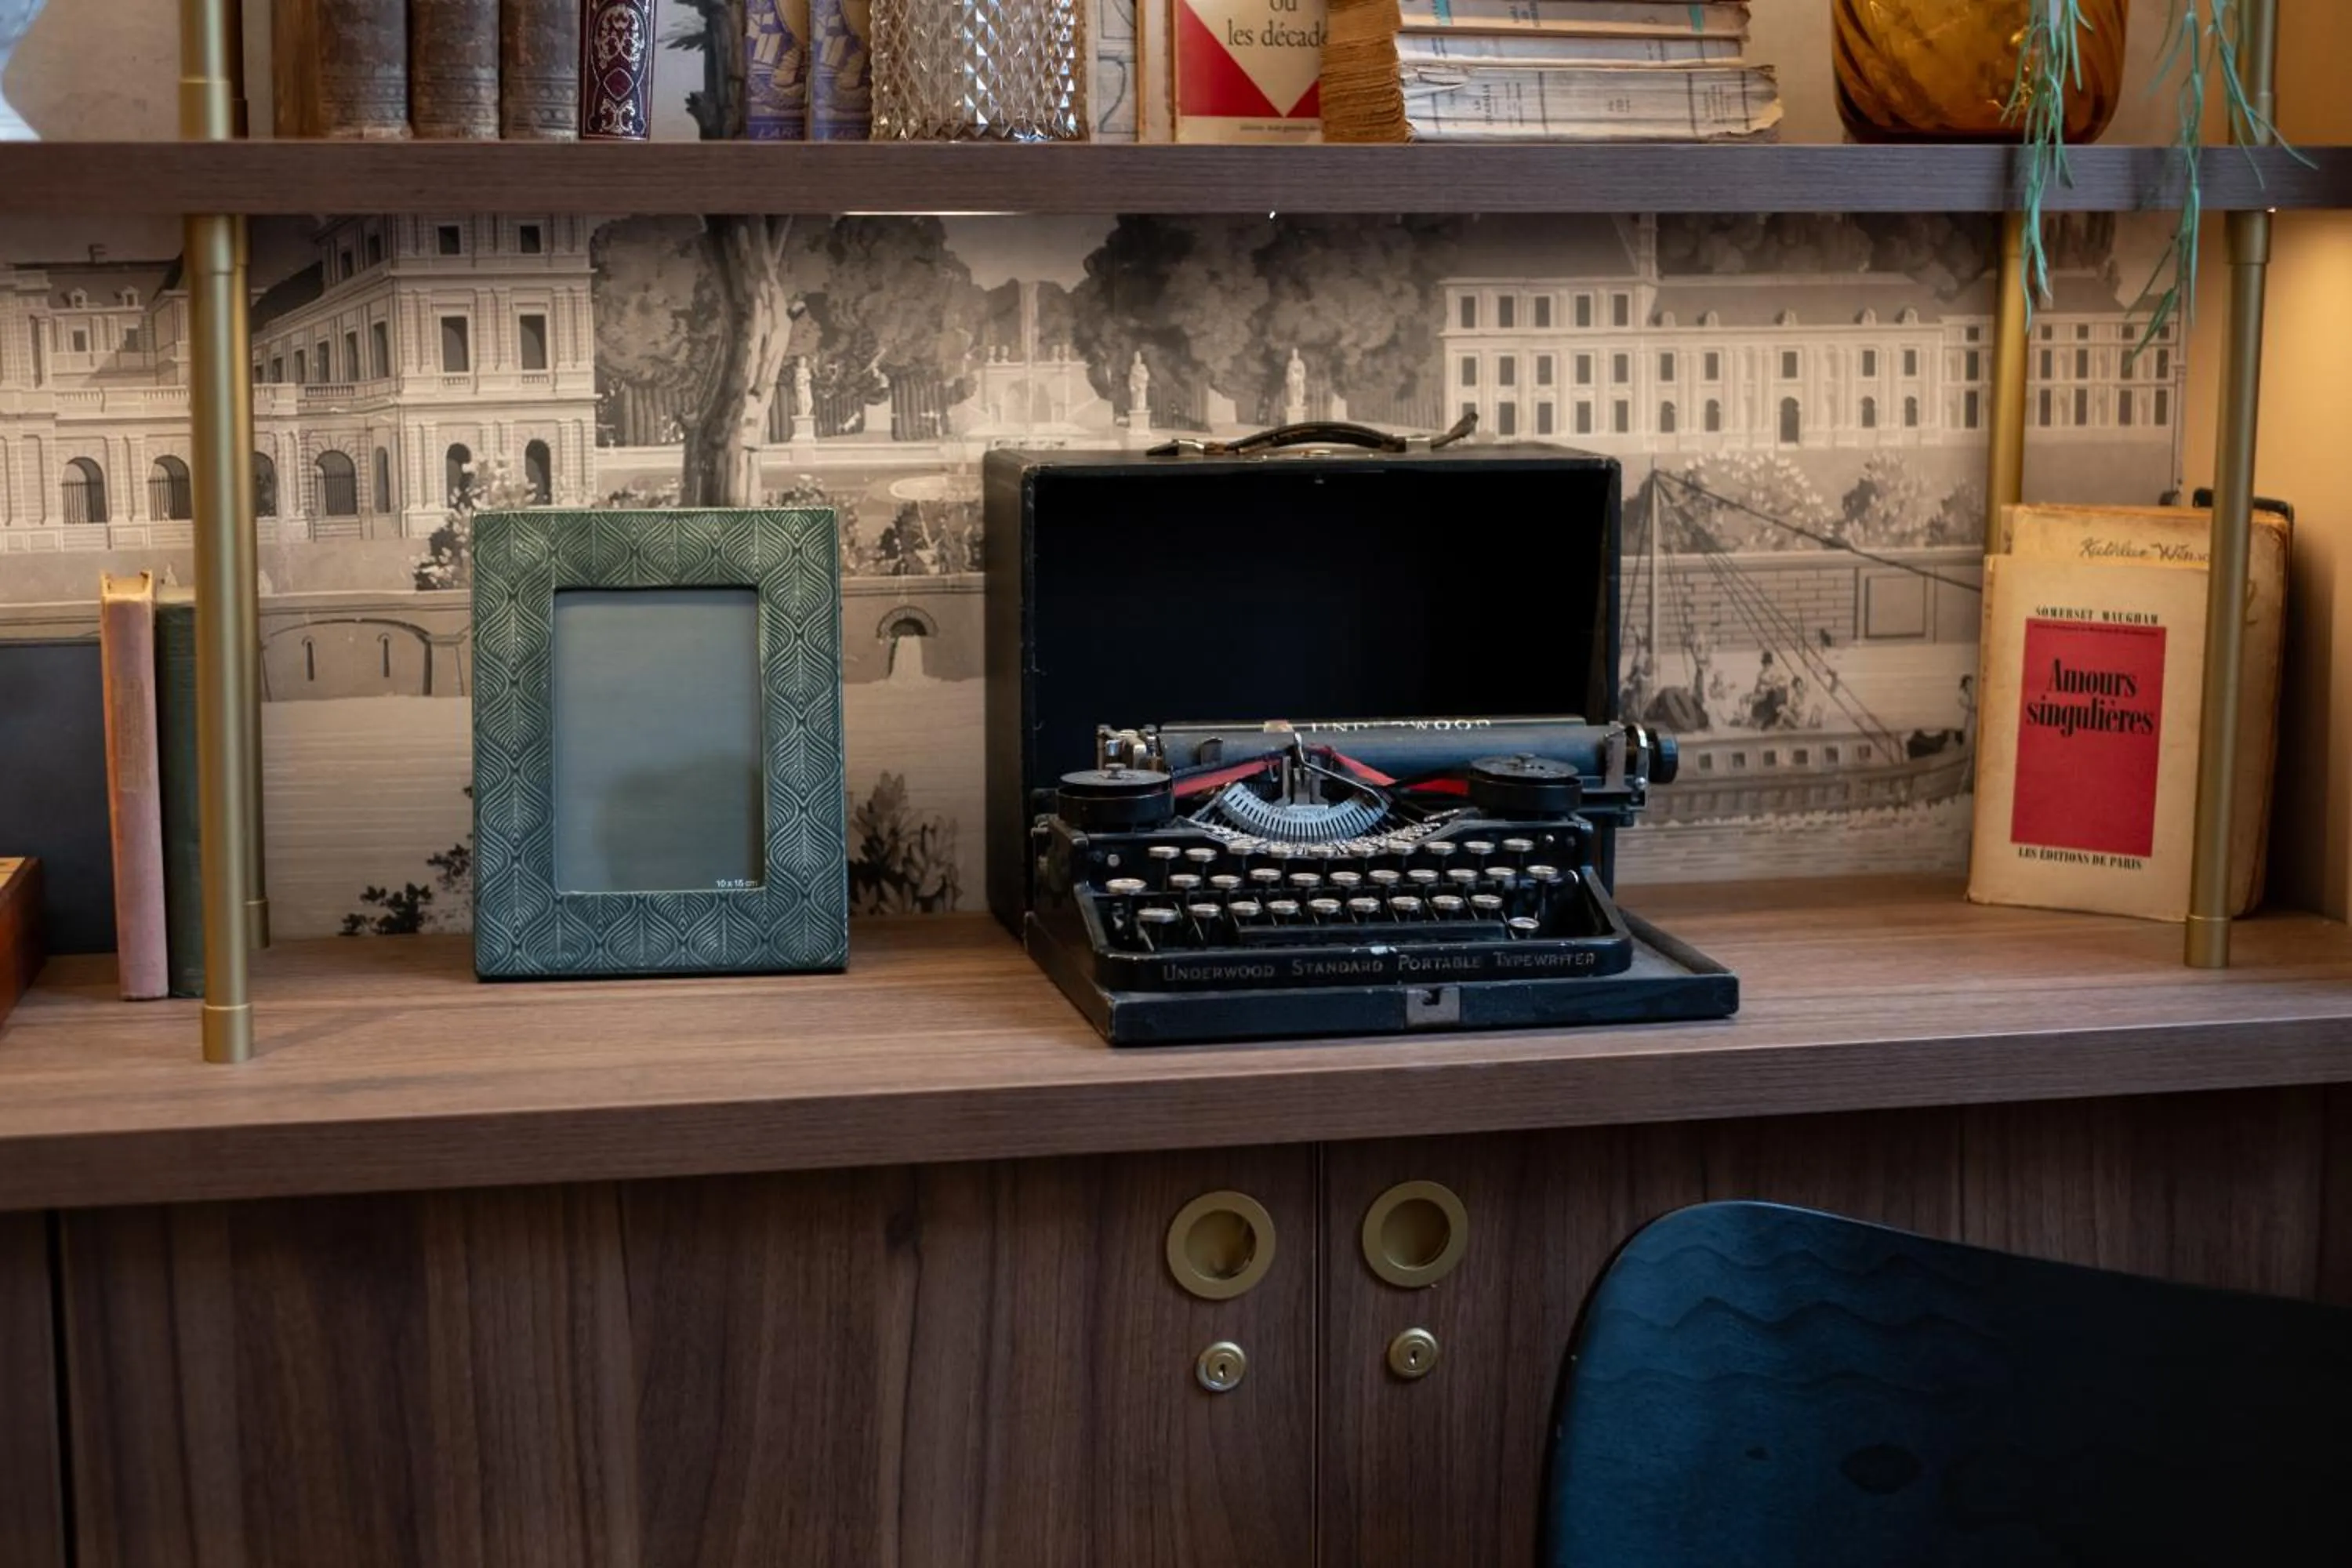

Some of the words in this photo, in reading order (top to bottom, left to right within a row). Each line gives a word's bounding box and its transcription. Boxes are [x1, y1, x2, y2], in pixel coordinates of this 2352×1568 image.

[1227, 18, 1254, 46] les
[2036, 606, 2093, 619] SOMERSET
[2102, 611, 2158, 625] MAUGHAM
[2046, 658, 2139, 698] Amours
[2026, 695, 2156, 738] singulières
[2018, 846, 2038, 859] LES
[2039, 846, 2090, 865] ÉDITIONS
[2092, 854, 2107, 866] DE
[2110, 856, 2142, 870] PARIS
[1163, 964, 1276, 981] UNDERWOOD
[1291, 958, 1385, 977] STANDARD
[1397, 953, 1481, 971] PORTABLE
[1493, 951, 1596, 968] TYPEWRITER
